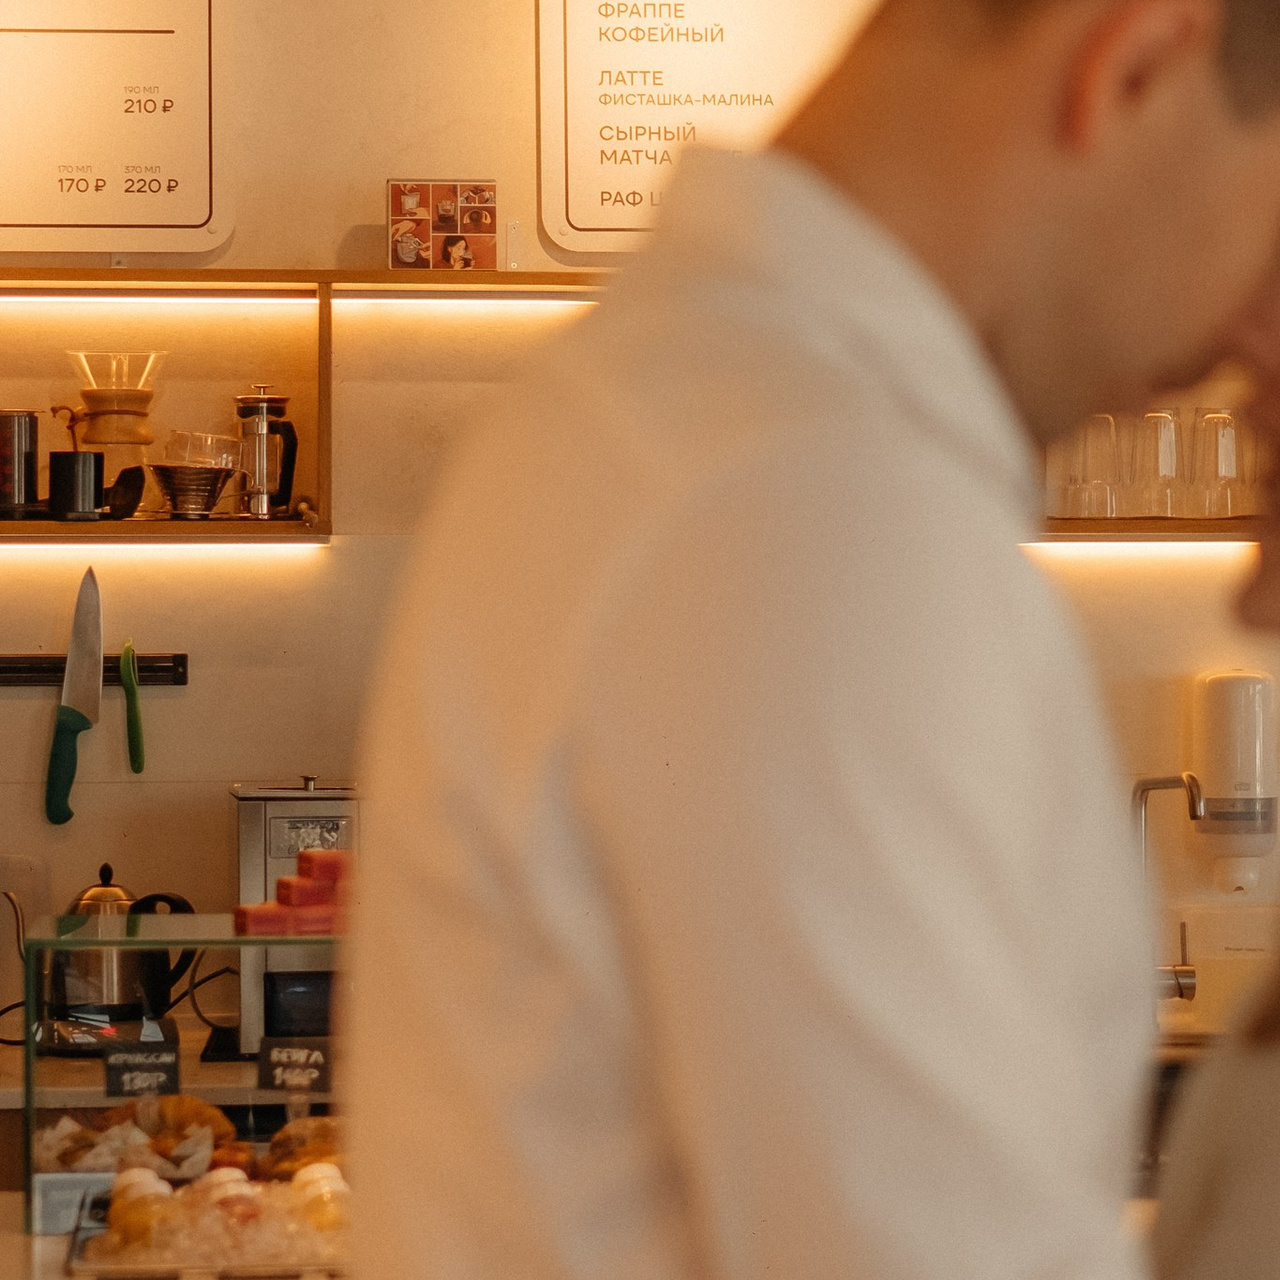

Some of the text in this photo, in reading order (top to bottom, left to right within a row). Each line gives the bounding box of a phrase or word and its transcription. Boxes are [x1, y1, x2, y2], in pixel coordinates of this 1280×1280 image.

[597, 1, 685, 19] ФРАППЕ
[598, 22, 724, 43] КОФЕЙНЫЙ
[598, 70, 664, 87] ЛАТТЕ
[123, 98, 175, 114] 210 ₽
[598, 122, 696, 142] СЫРНЫЙ
[599, 149, 673, 165] МАТЧА
[57, 177, 107, 194] 170 ₽
[124, 178, 179, 194] 220 ₽
[600, 190, 644, 207] РАФ
